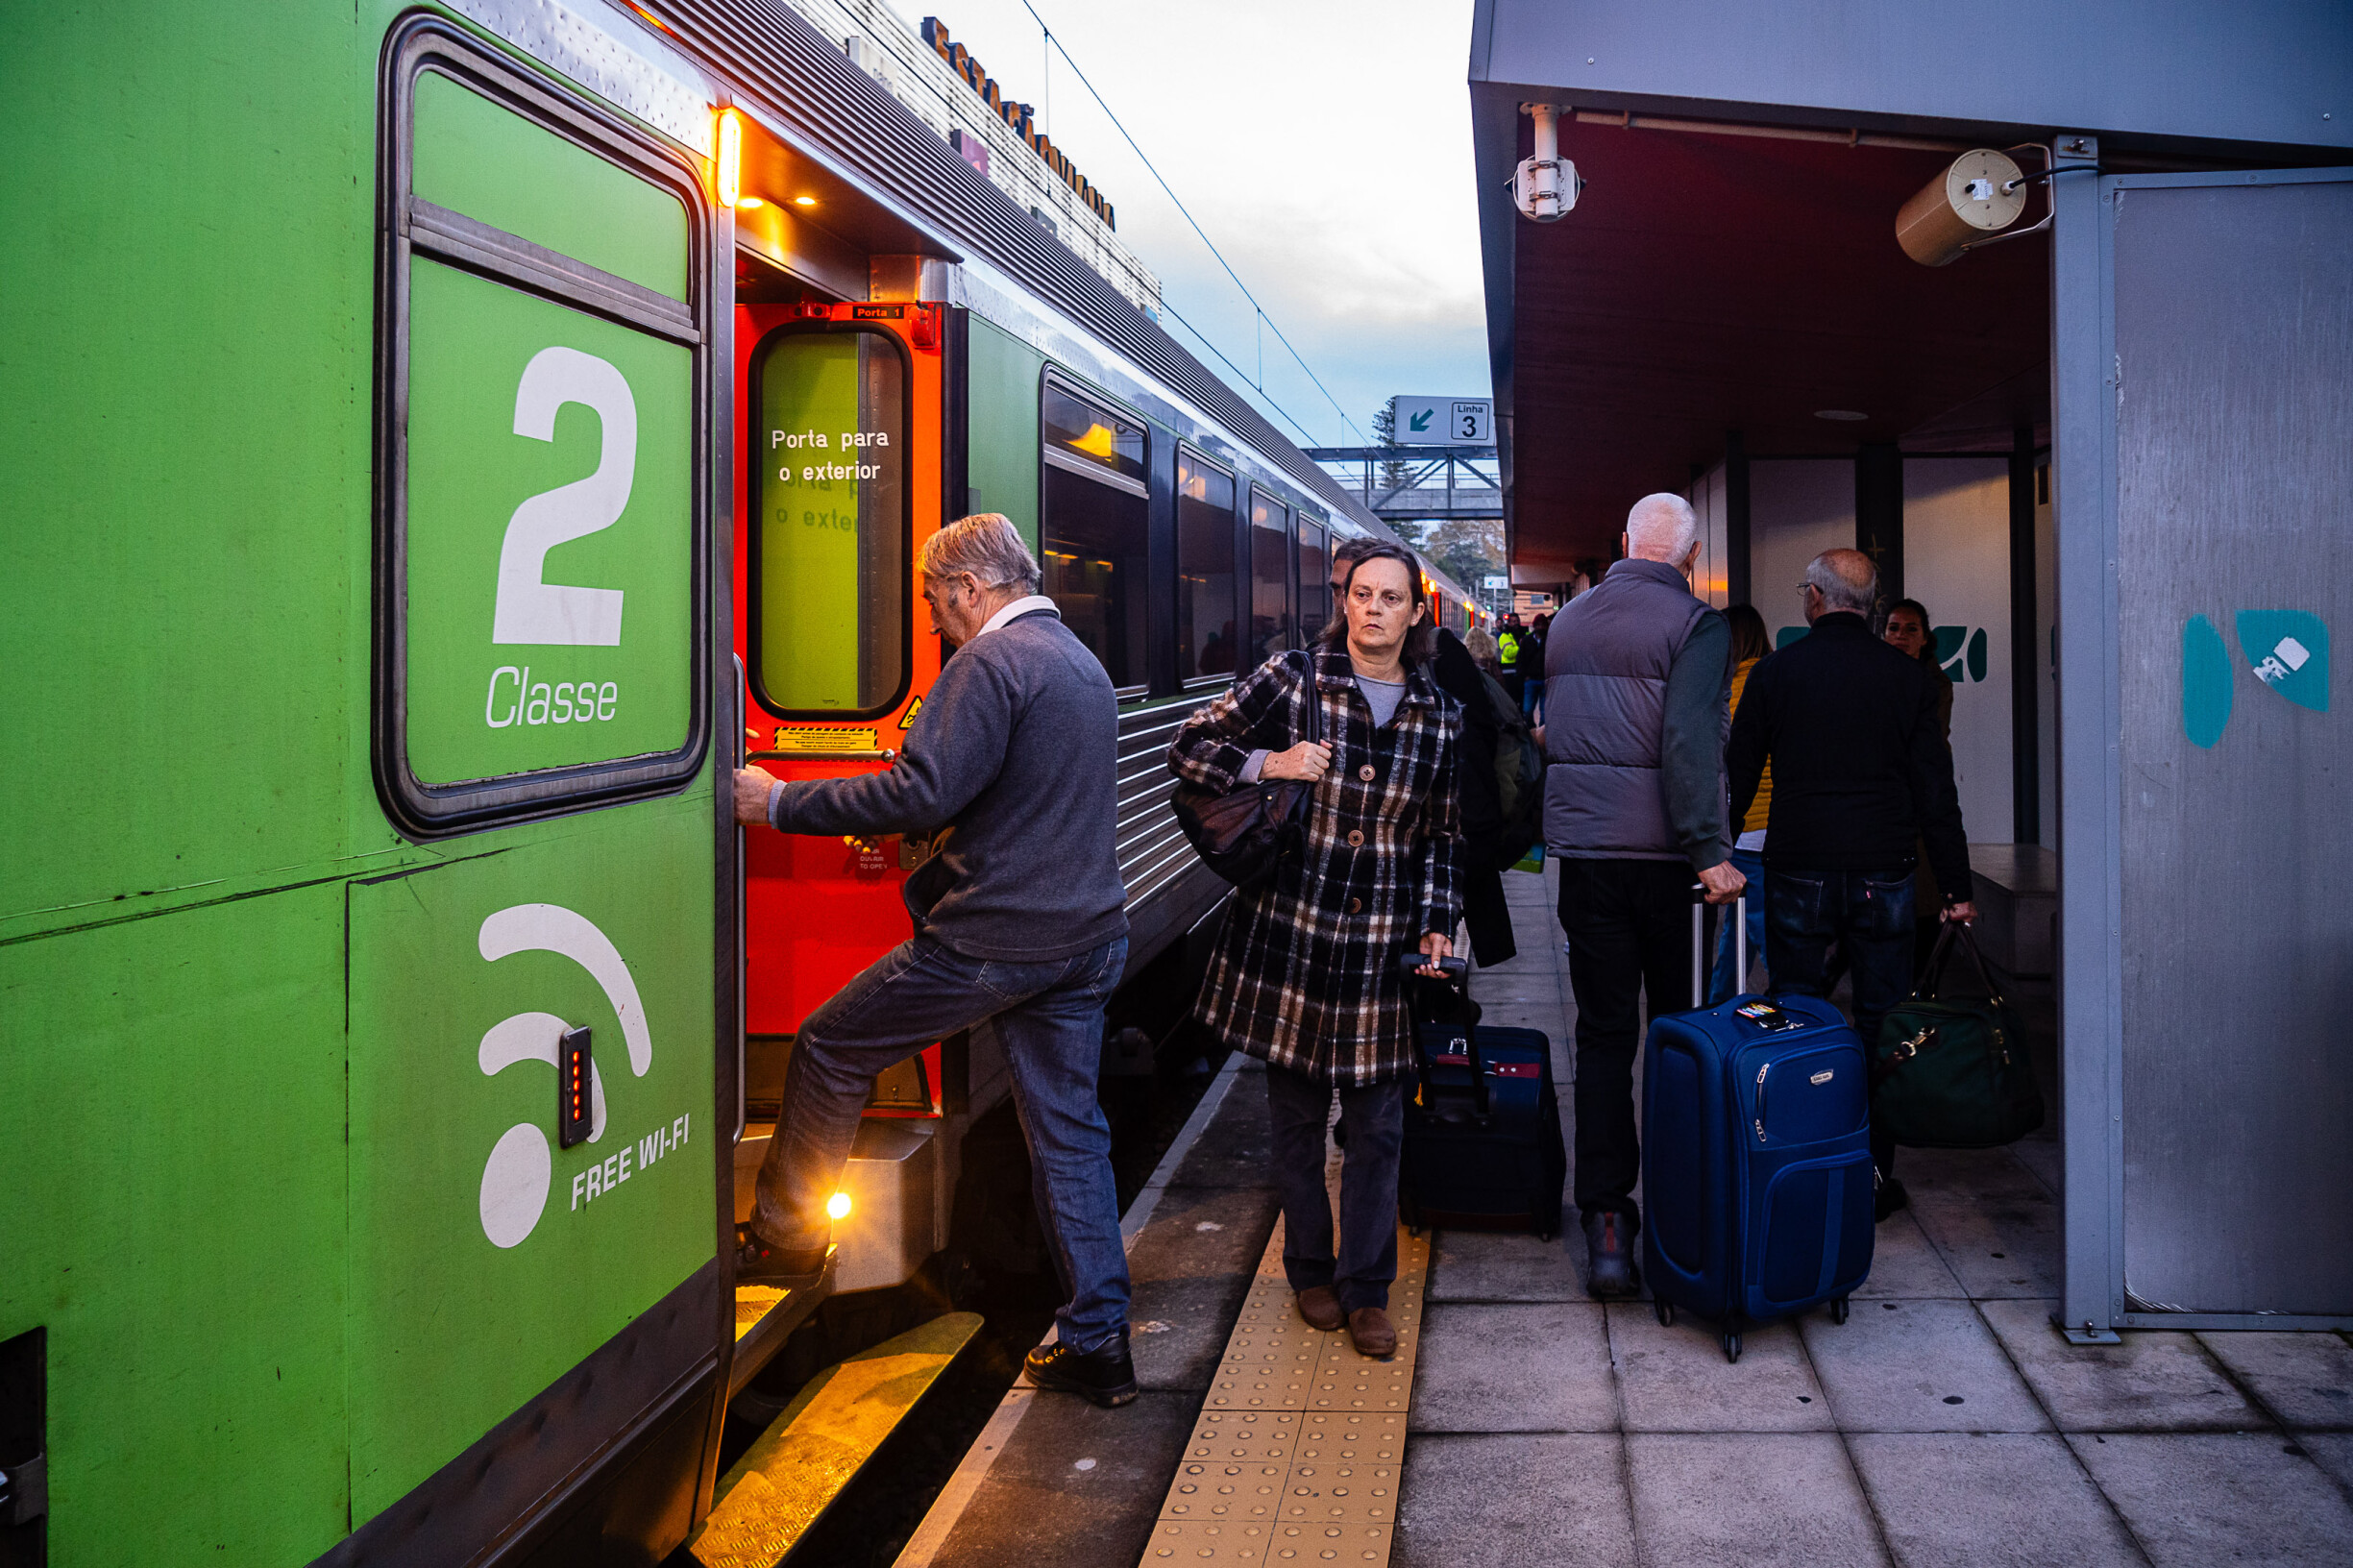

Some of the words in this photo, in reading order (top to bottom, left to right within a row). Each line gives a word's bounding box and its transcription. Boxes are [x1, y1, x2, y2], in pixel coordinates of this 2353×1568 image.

[857, 308, 888, 317] Porta
[895, 308, 900, 317] 1
[1458, 404, 1483, 413] Linha
[1461, 415, 1477, 438] 3
[772, 429, 828, 449] Porta
[841, 431, 890, 452] para
[779, 467, 791, 481] o
[802, 461, 881, 480] exterior
[492, 346, 638, 647] 2
[485, 665, 618, 728] Classe
[571, 1145, 633, 1212] FREE
[639, 1113, 690, 1171] WI-FI
